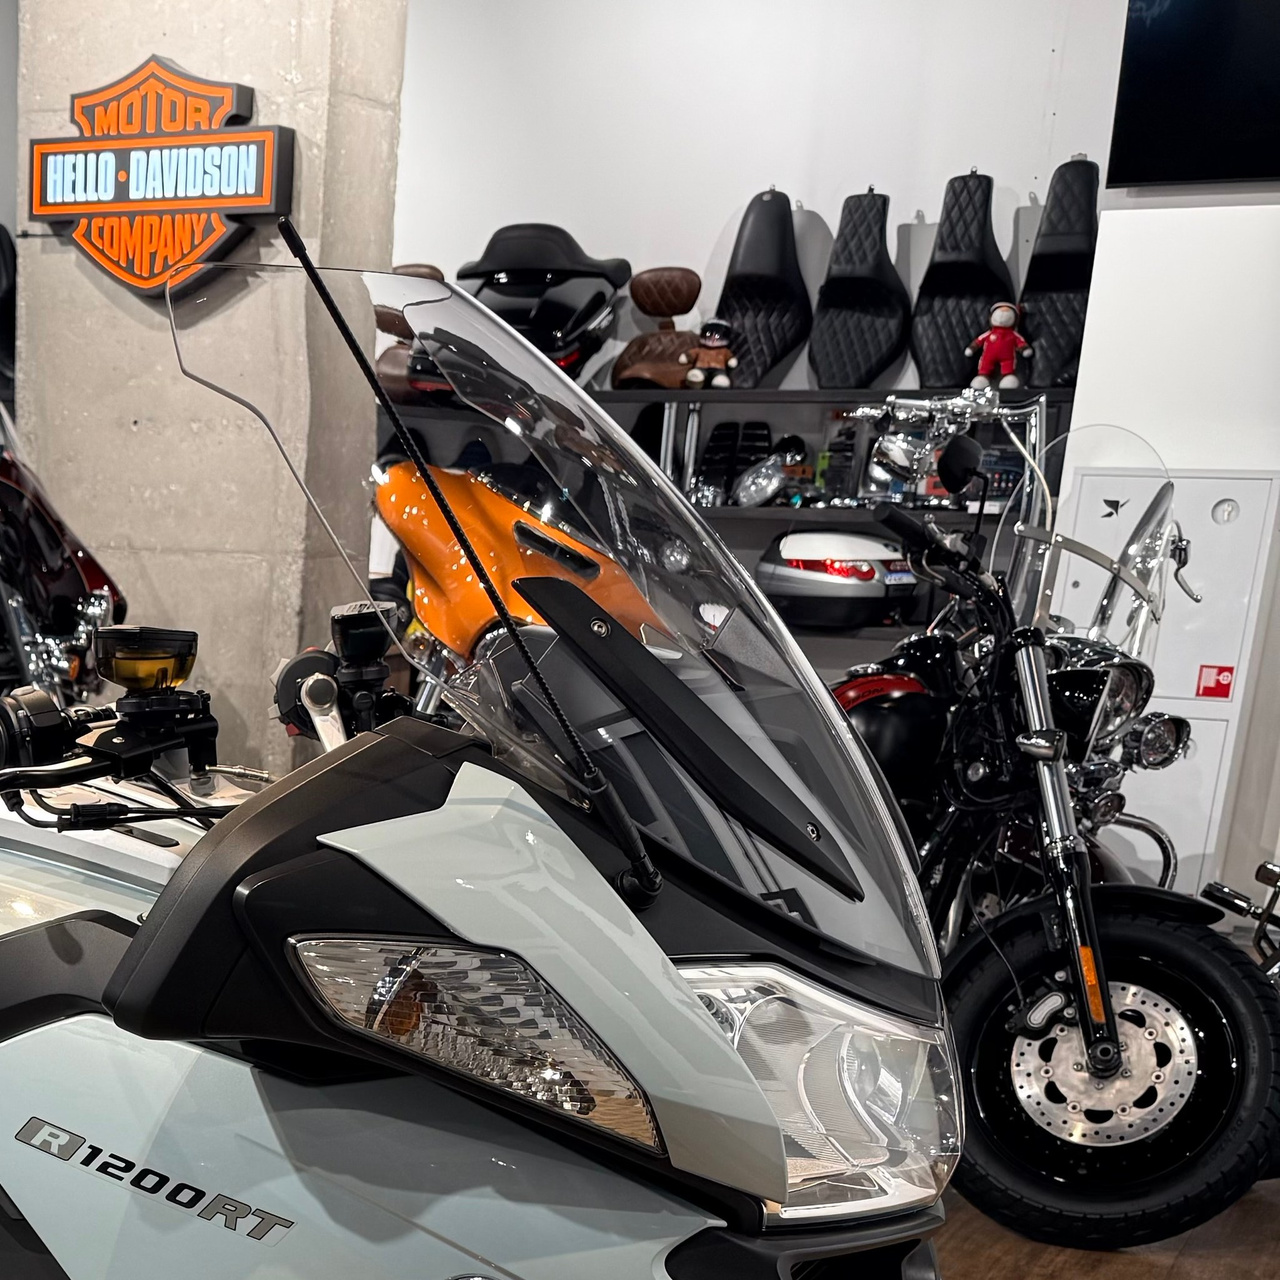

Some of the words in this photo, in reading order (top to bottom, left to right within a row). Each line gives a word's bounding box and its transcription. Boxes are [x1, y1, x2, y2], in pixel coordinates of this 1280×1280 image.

[94, 78, 210, 136] MOTOR
[46, 152, 116, 203] HELLO
[129, 145, 257, 199] DAVIDSON
[91, 213, 208, 277] COMPANY
